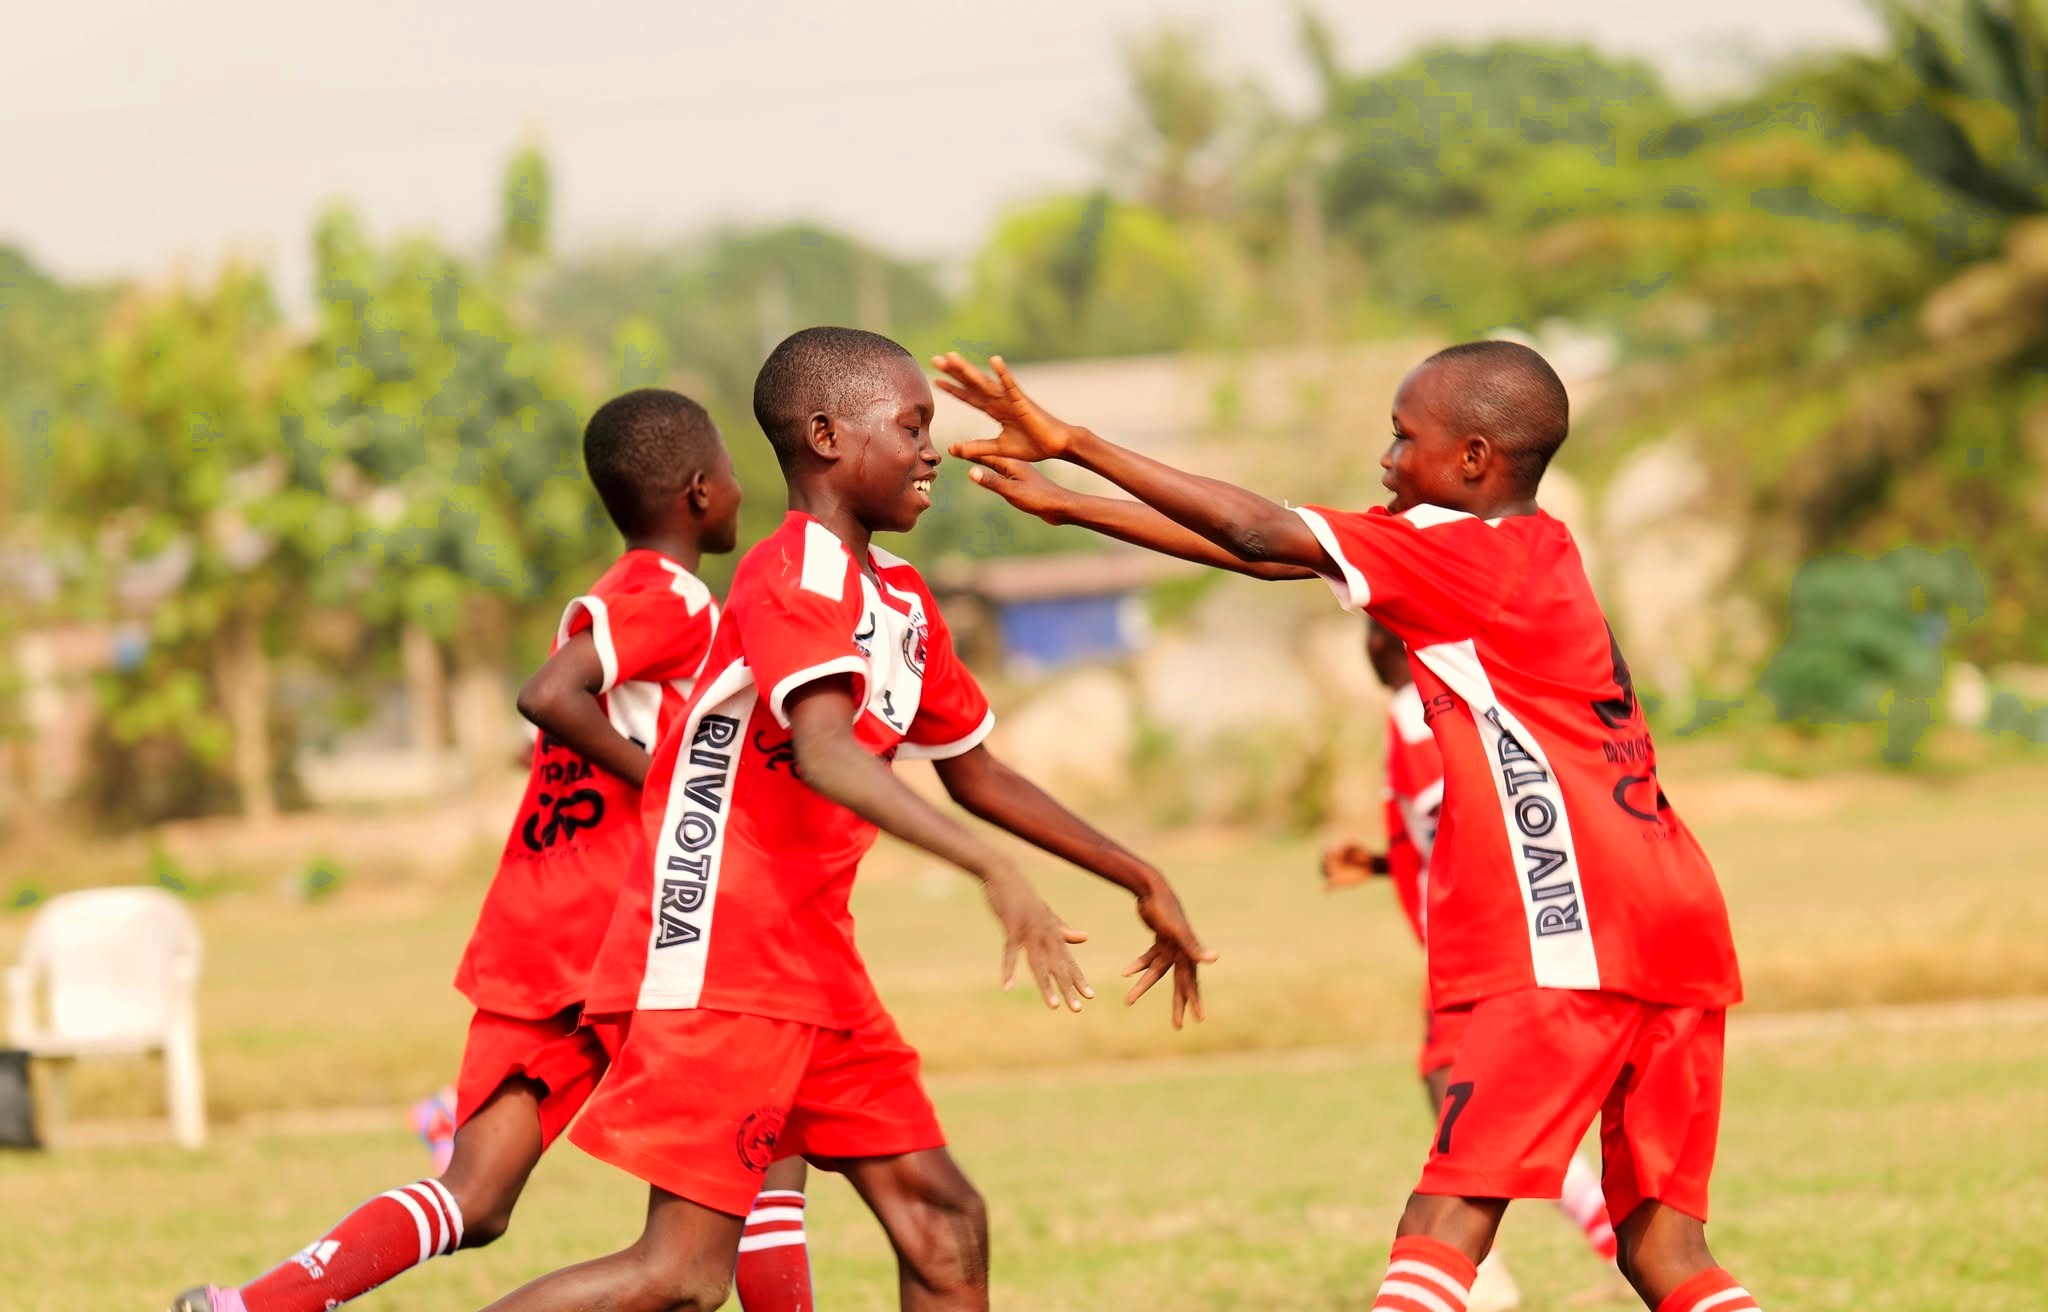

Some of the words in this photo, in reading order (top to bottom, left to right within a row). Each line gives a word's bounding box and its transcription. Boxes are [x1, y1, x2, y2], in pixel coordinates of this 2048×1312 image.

[656, 714, 740, 949] RIVOTRA
[1485, 706, 1583, 938] RIVOTR
[1437, 1081, 1474, 1154] 7
